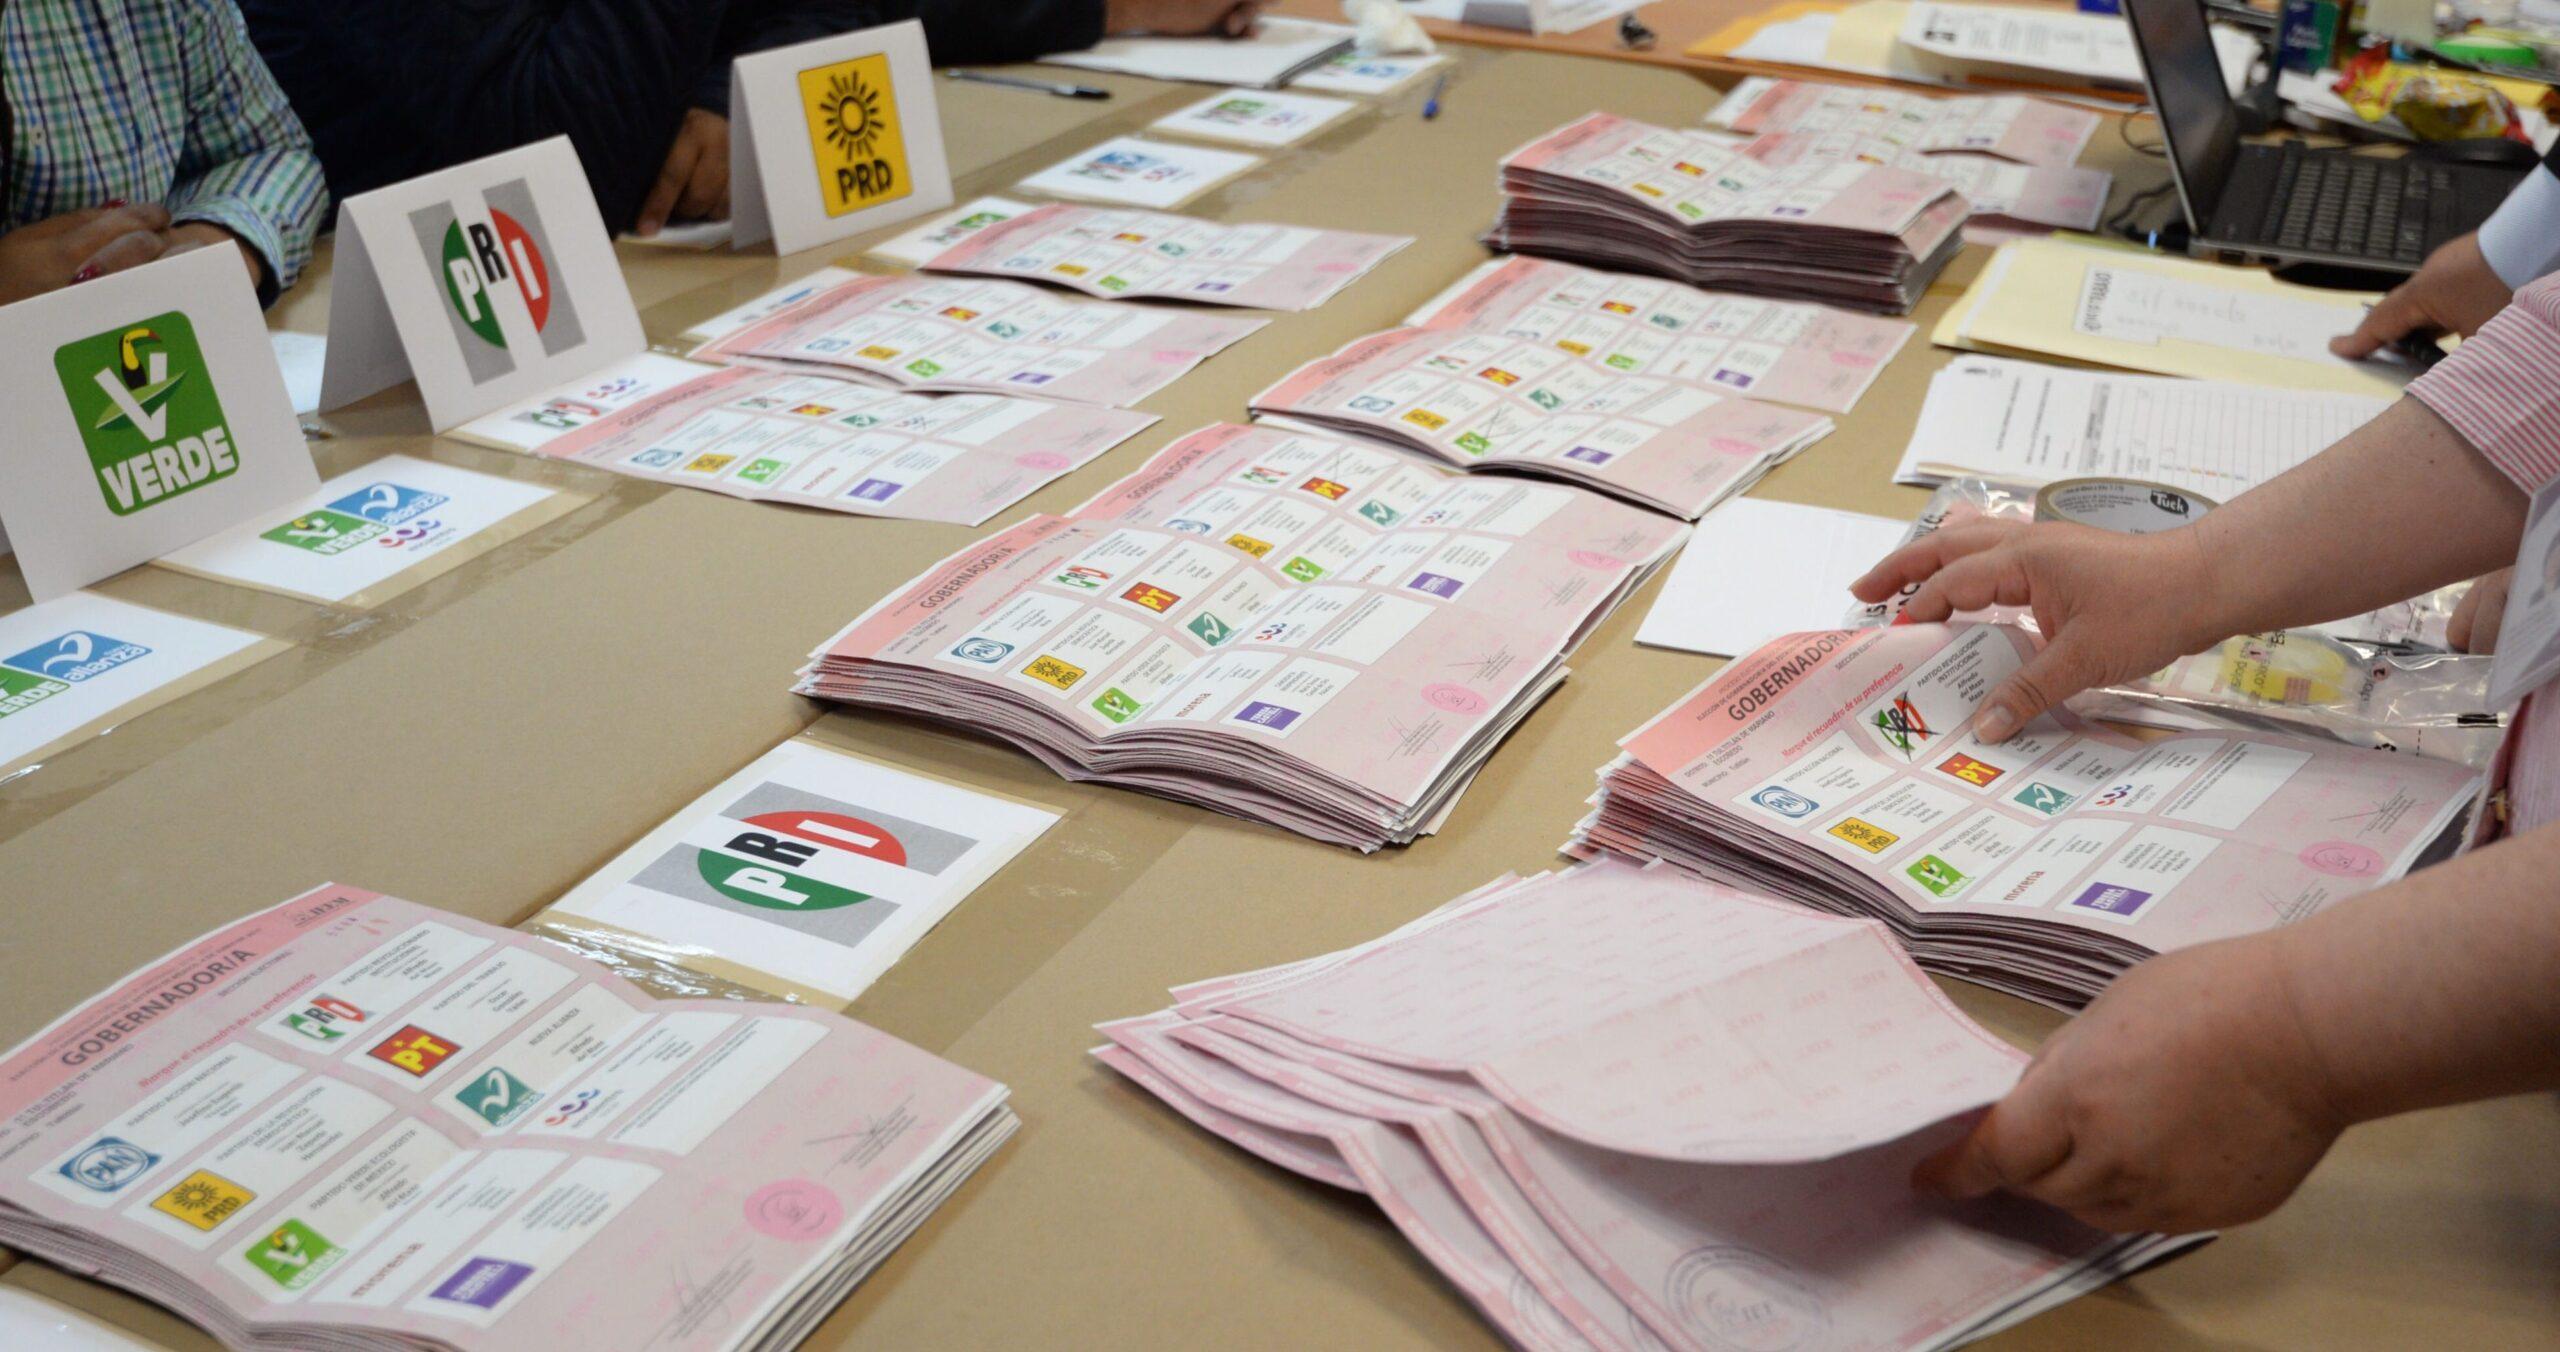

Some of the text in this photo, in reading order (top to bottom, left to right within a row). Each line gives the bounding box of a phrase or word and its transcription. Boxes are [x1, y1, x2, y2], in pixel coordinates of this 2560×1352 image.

[836, 158, 892, 204] PRD
[448, 222, 542, 323] PRI
[101, 426, 236, 509] VERDE
[2152, 492, 2186, 514] Tuck
[920, 546, 1015, 609] GOBERNADOR/A
[1138, 588, 1174, 611] PT
[64, 645, 146, 680] alianza
[968, 643, 996, 659] PAN
[1057, 671, 1078, 685] PRD
[1917, 666, 1943, 688] PARTIDO
[0, 681, 65, 715] ERDE
[1782, 739, 1806, 757] Marque
[1812, 711, 1845, 740] recuadro
[1861, 663, 1904, 700] preferencia
[1955, 761, 1997, 784] PT
[1768, 794, 1801, 811] PAN
[1867, 834, 1891, 849] PRD
[723, 819, 881, 906] PRI
[2003, 871, 2047, 901] morena
[61, 949, 257, 1067] GOBERNADOR/A
[298, 1003, 357, 1039] PRI
[391, 1034, 449, 1073] PT
[203, 1196, 242, 1223] PRD
